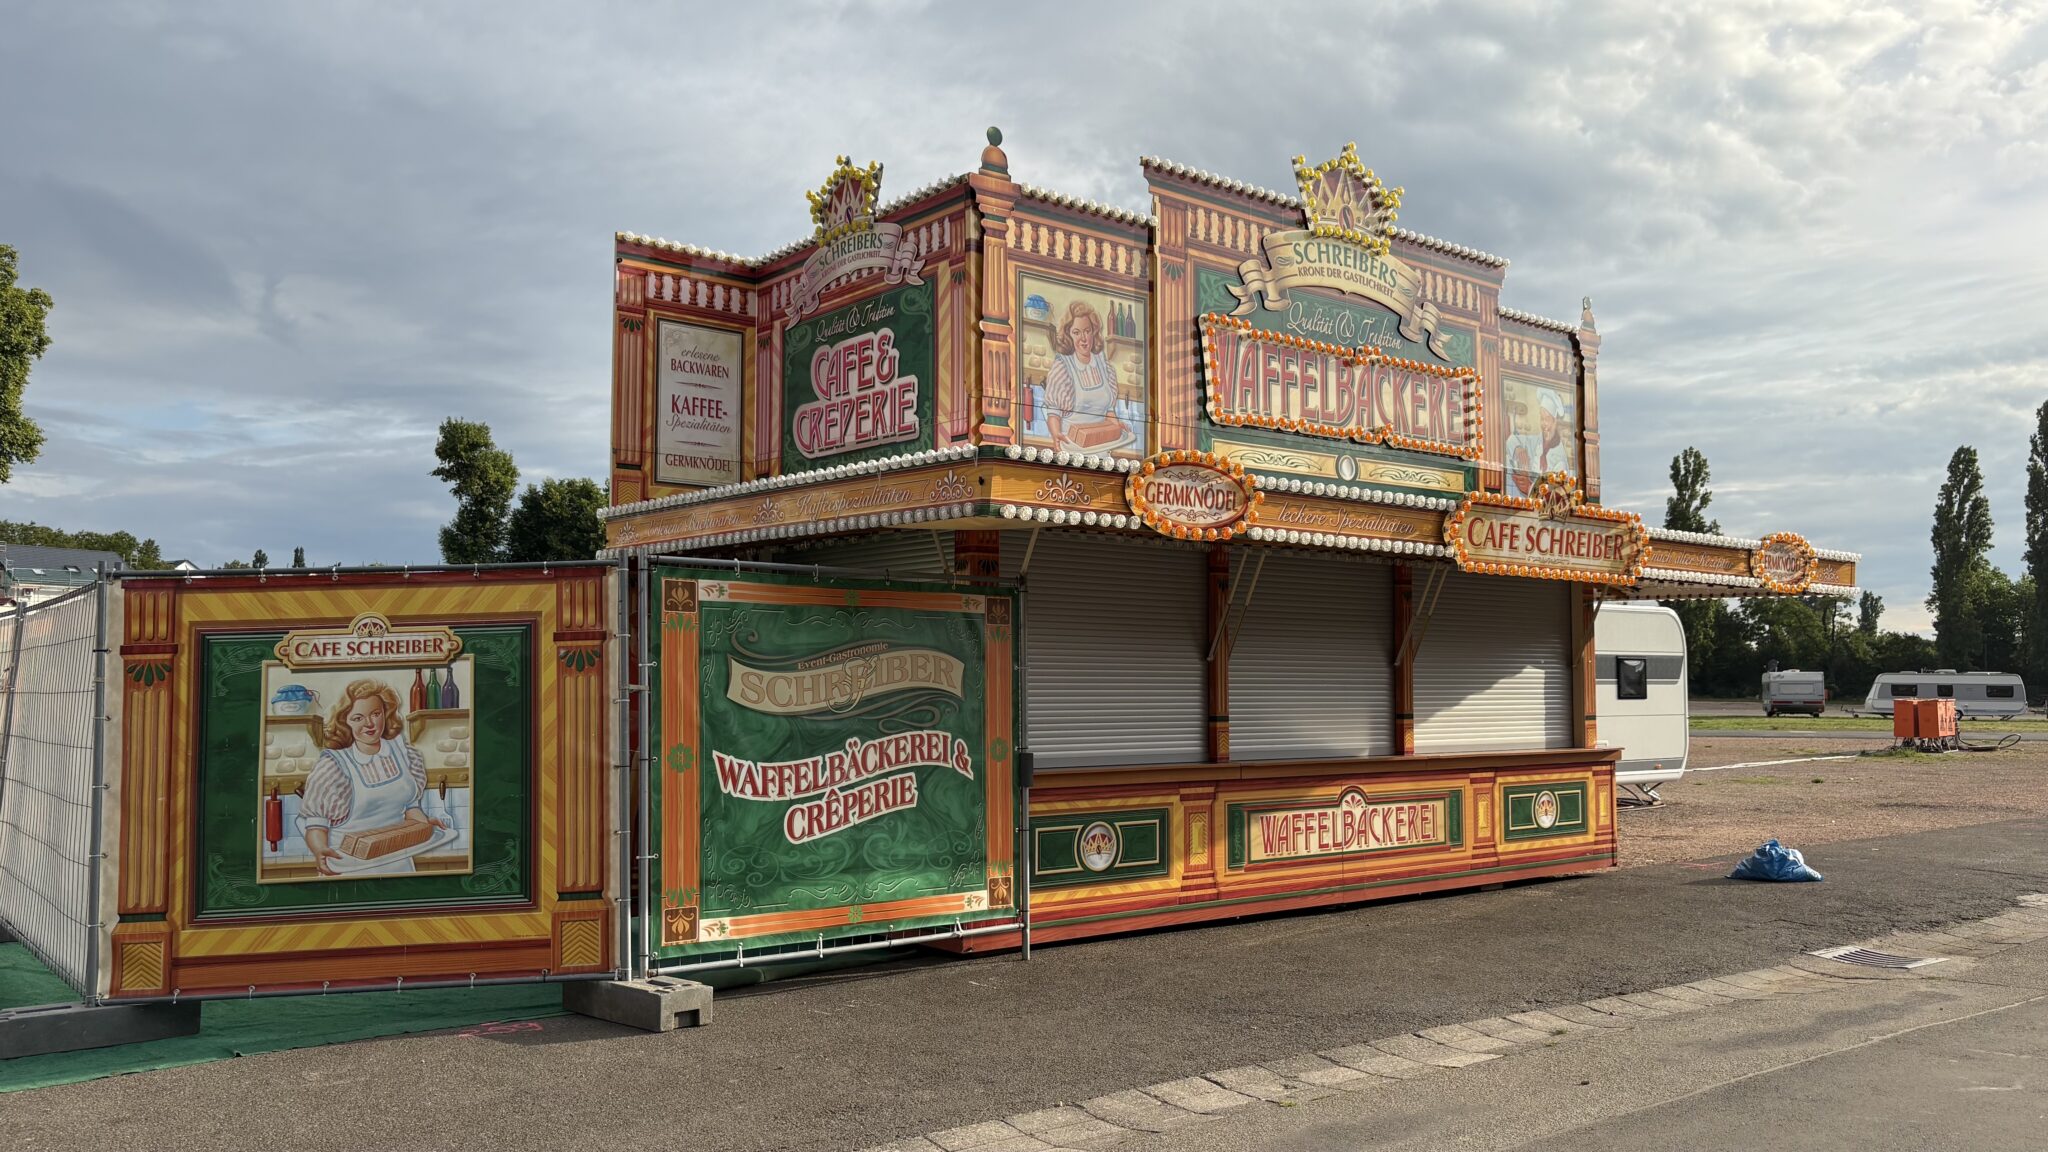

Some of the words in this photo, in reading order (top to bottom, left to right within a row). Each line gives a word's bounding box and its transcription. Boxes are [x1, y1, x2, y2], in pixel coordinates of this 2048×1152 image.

[819, 232, 884, 271] SCHREIBERS
[1293, 241, 1398, 289] SCHREIBERS
[1297, 266, 1326, 278] KRONE
[1326, 267, 1342, 279] DER
[1343, 271, 1395, 298] GASTLICHKEIT
[1287, 302, 1334, 335] Qualität
[1336, 310, 1355, 344] &
[1358, 317, 1404, 350] Tradition
[670, 358, 730, 379] BACKWAREN
[681, 346, 720, 362] erlesene
[671, 393, 728, 419] KAFFEE-
[796, 382, 917, 453] CREPERIE
[666, 414, 732, 434] Spezialitäten
[665, 453, 732, 472] GERMKNÖDEL
[796, 484, 913, 521] Kaffeespezialitäten
[1144, 481, 1238, 511] GERMKNÖDEL
[1277, 501, 1327, 525] leckere
[1329, 507, 1415, 534] Spezialitäten
[1467, 517, 1520, 550] CAFE
[1525, 524, 1625, 561] SCHREIBER
[294, 641, 341, 658] CAFE
[346, 637, 444, 656] SCHREIBER
[798, 641, 889, 670] Event-Gastronomie
[740, 653, 957, 708] SCHREIBER
[715, 732, 951, 799] WAFFELBÄCKEREI
[954, 740, 972, 777] &
[786, 776, 917, 842] CRÊPERIE
[1260, 803, 1438, 856] WAFFELBÄCKEREI
